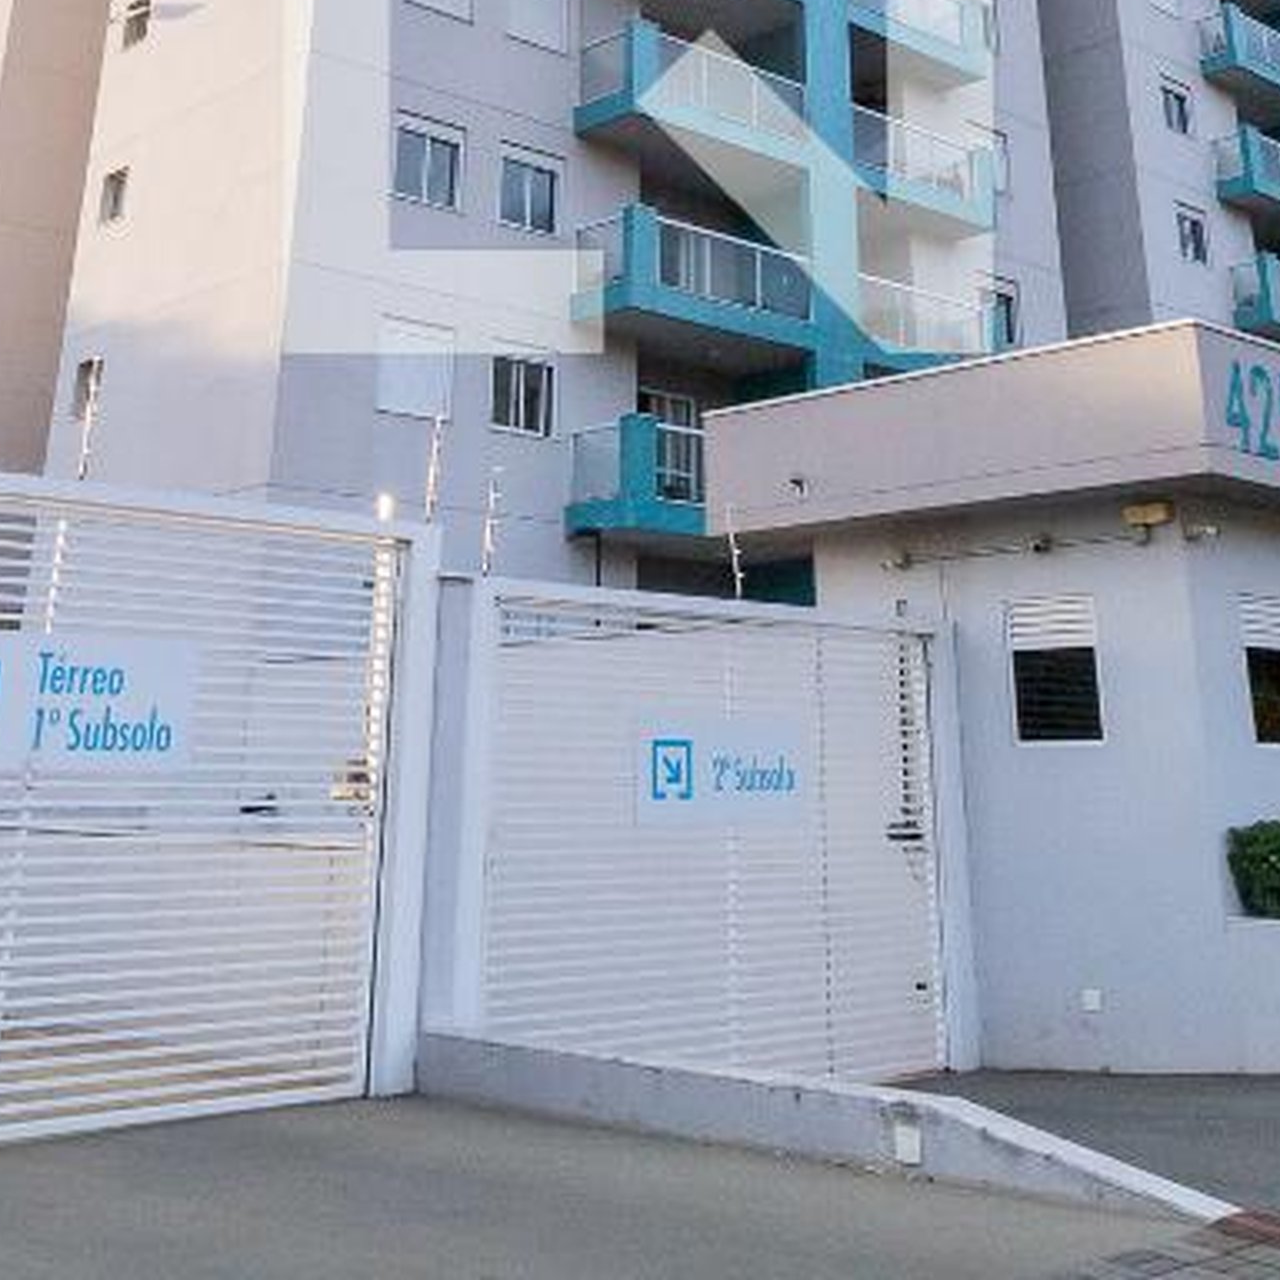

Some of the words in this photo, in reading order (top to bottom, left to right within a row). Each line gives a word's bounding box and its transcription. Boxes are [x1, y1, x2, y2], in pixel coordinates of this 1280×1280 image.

[38, 650, 125, 695] Térreo
[66, 704, 172, 751] Subsolo
[733, 754, 795, 791] Subsolo
